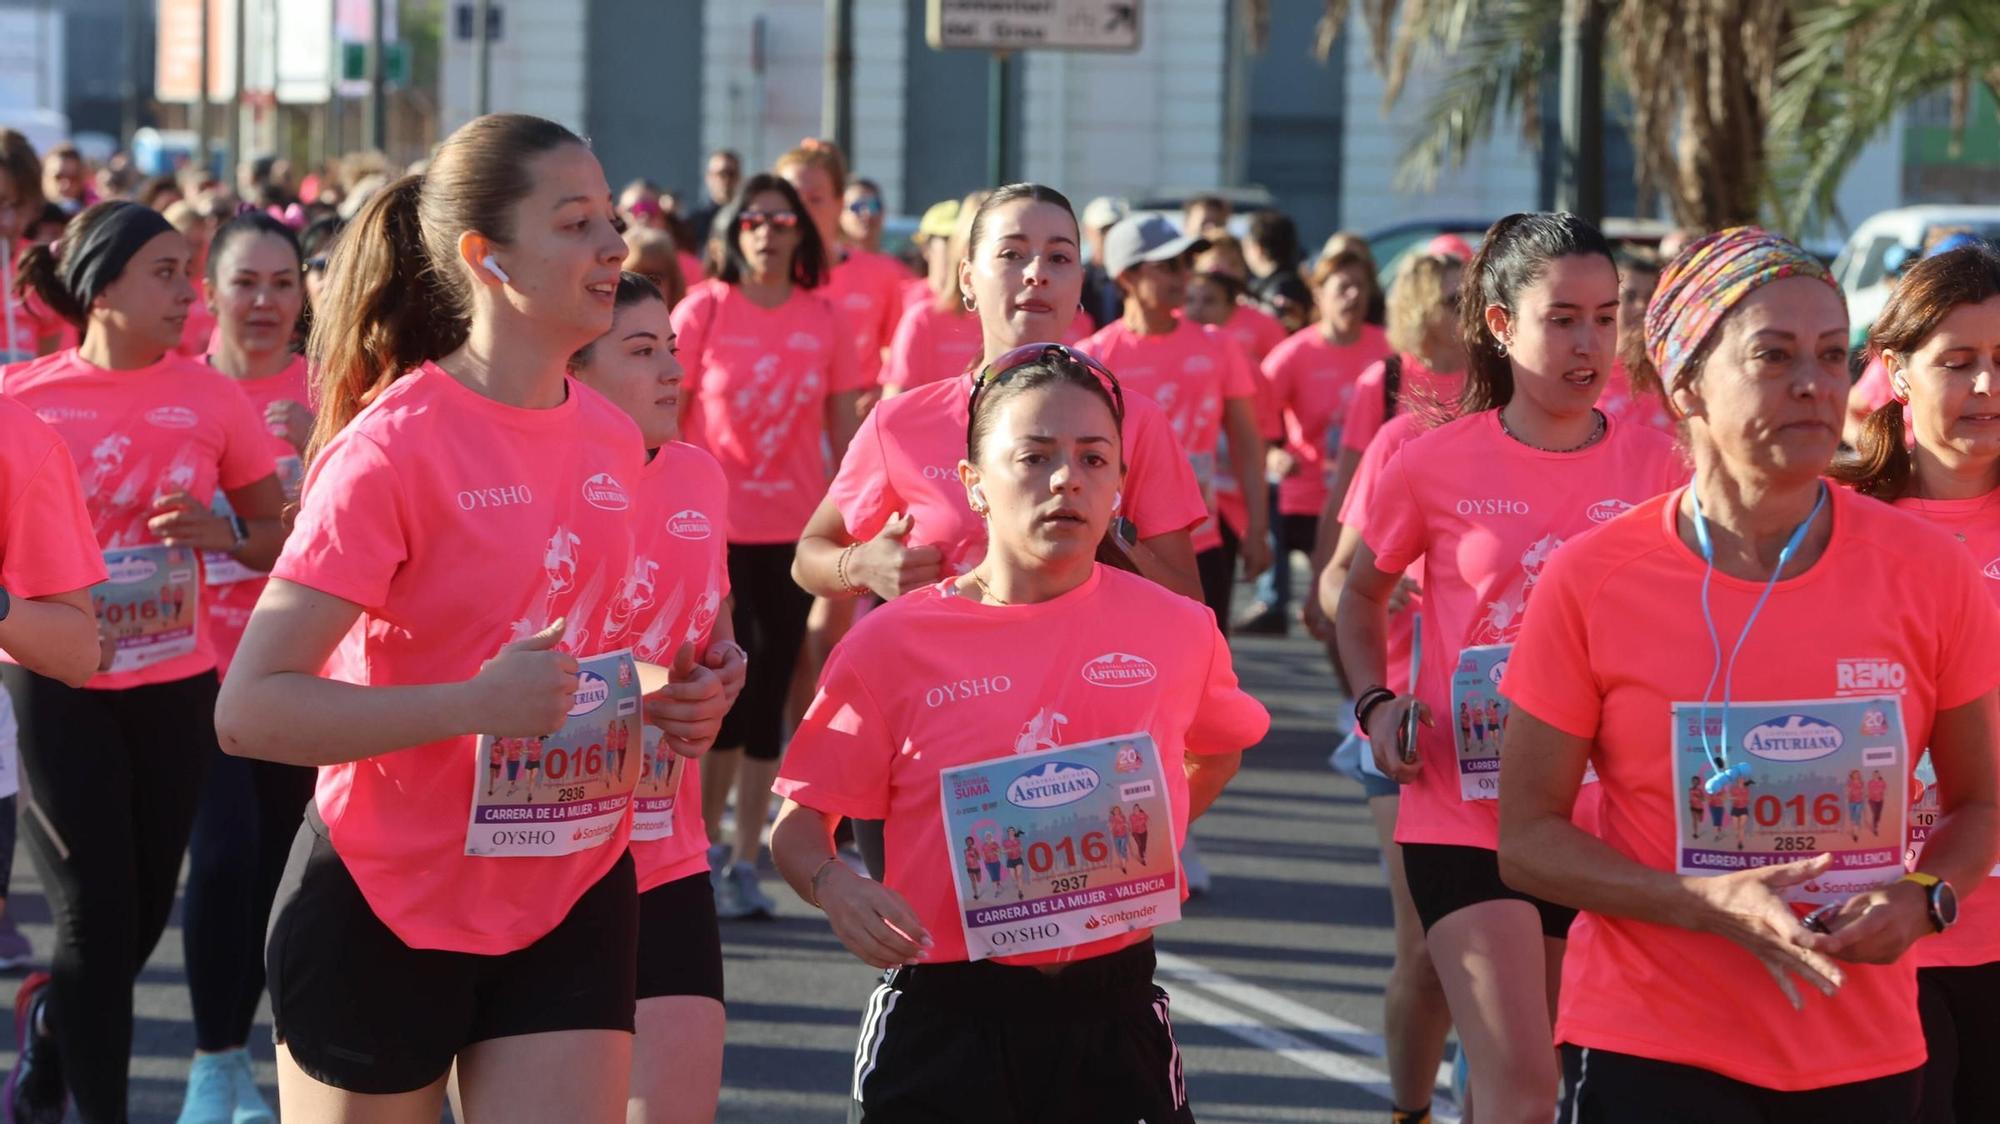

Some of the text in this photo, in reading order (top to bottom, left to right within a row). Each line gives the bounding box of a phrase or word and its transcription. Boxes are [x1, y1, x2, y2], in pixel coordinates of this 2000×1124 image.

[457, 484, 533, 511] OYSHO
[1456, 499, 1529, 515] OYSHO
[106, 600, 157, 625] 016
[1089, 666, 1151, 680] ASTURIANA
[1836, 662, 1906, 688] REMO
[926, 675, 1011, 708] OYSHO
[1750, 733, 1837, 751] ASTURIANA
[544, 743, 601, 780] 016
[1119, 749, 1137, 765] 20
[558, 785, 585, 802] 2936
[954, 783, 992, 800] SUMA
[1014, 777, 1095, 803] ASTURIANA
[485, 805, 533, 820] CARRERA
[536, 805, 551, 819] DE
[553, 804, 565, 818] LA
[568, 802, 592, 818] MUJER
[1754, 792, 1841, 827] 016
[492, 829, 555, 846] OYSHO
[1774, 836, 1816, 851] 2852
[1027, 831, 1109, 873] 016
[1692, 853, 1747, 868] CARRERA
[1750, 854, 1766, 867] DE
[1842, 851, 1892, 867] VALENCIA
[1051, 874, 1089, 894] 2937
[976, 878, 1166, 924] CARRERA DE LA MUJER VALENCIA
[991, 903, 1158, 946] OYSHO Santander
